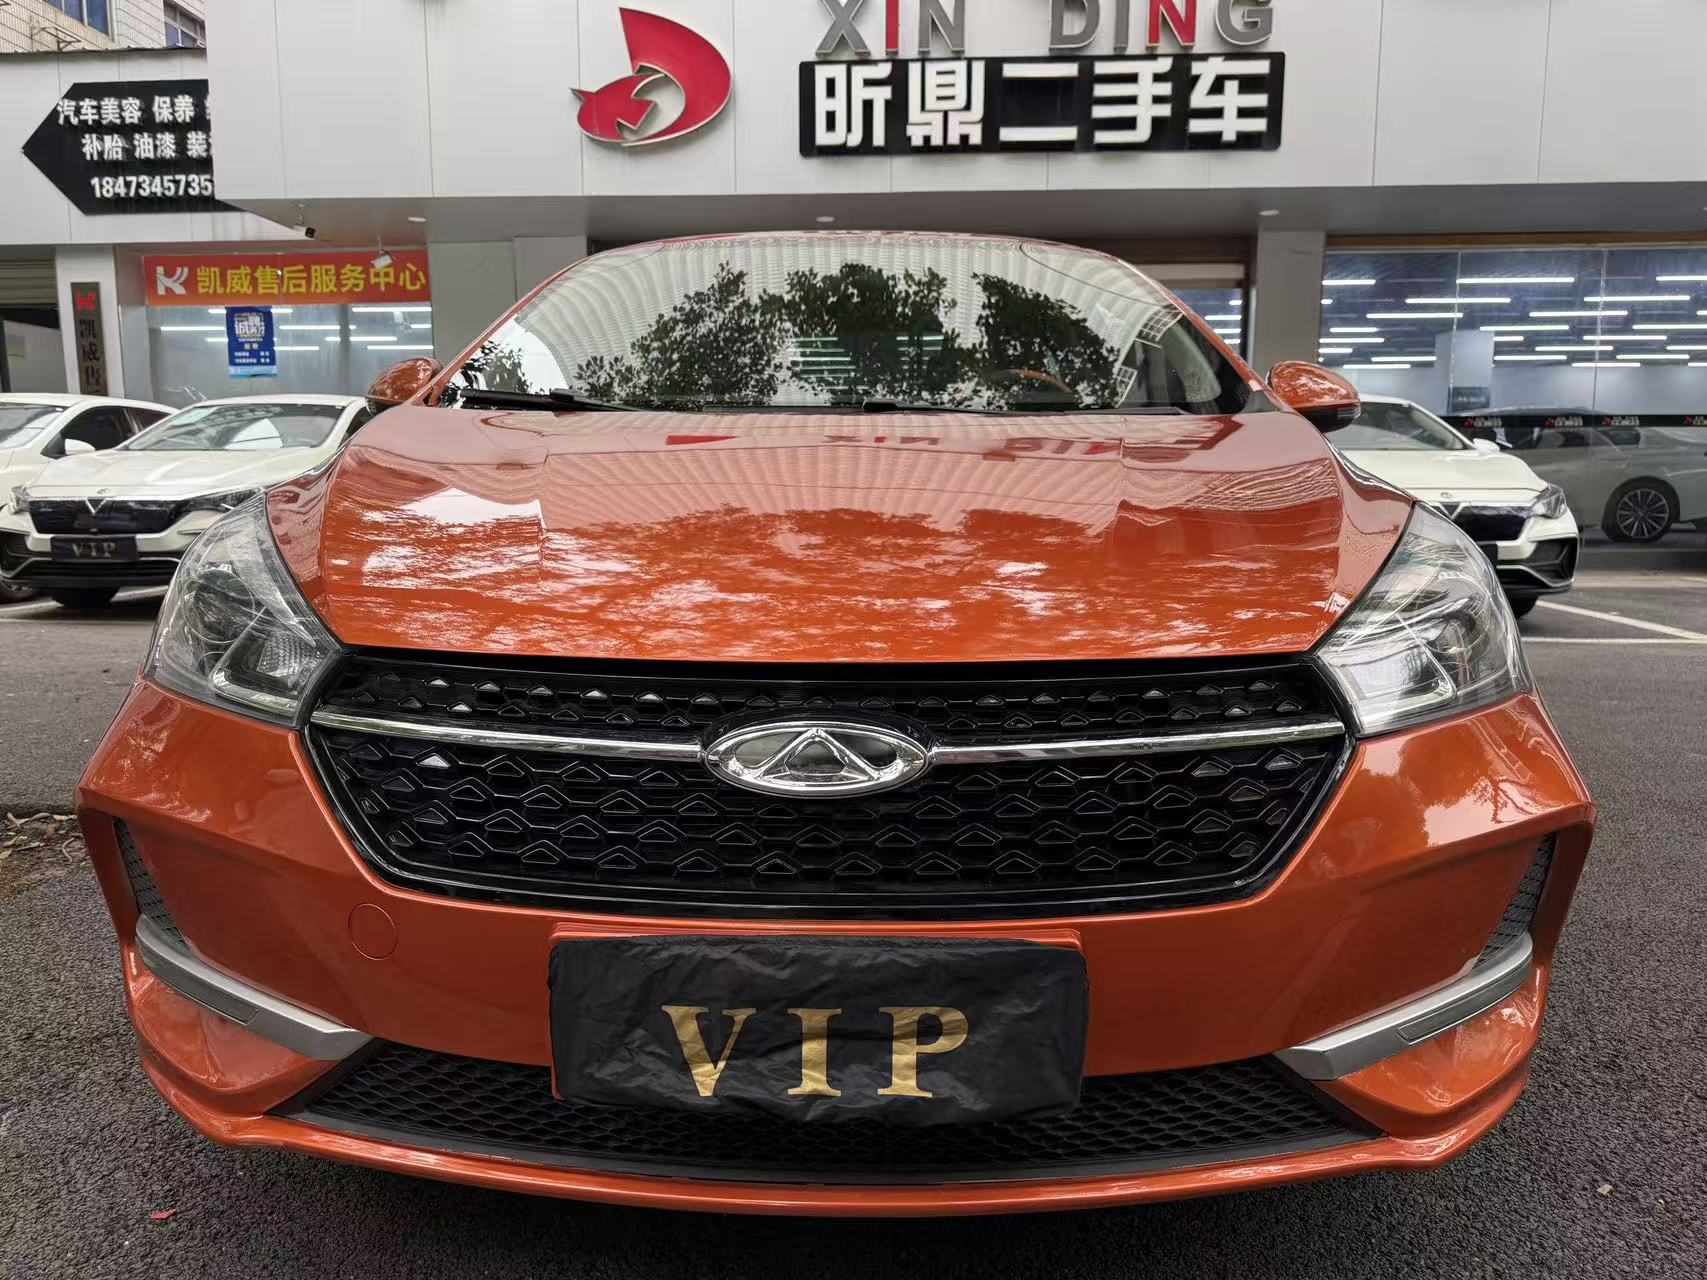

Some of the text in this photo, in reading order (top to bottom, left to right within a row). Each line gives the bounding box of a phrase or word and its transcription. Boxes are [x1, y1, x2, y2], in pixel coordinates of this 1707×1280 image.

[815, 0, 1273, 55] XIN DING
[56, 96, 142, 126] 汽车美容
[152, 94, 195, 123] 保养
[814, 57, 1271, 148] 昕鼎二手车
[81, 130, 213, 161] 补胎 油漆 装
[197, 262, 426, 295] 凯威售后服务中心
[72, 542, 116, 557] VIP
[661, 1004, 969, 1098] VIP
